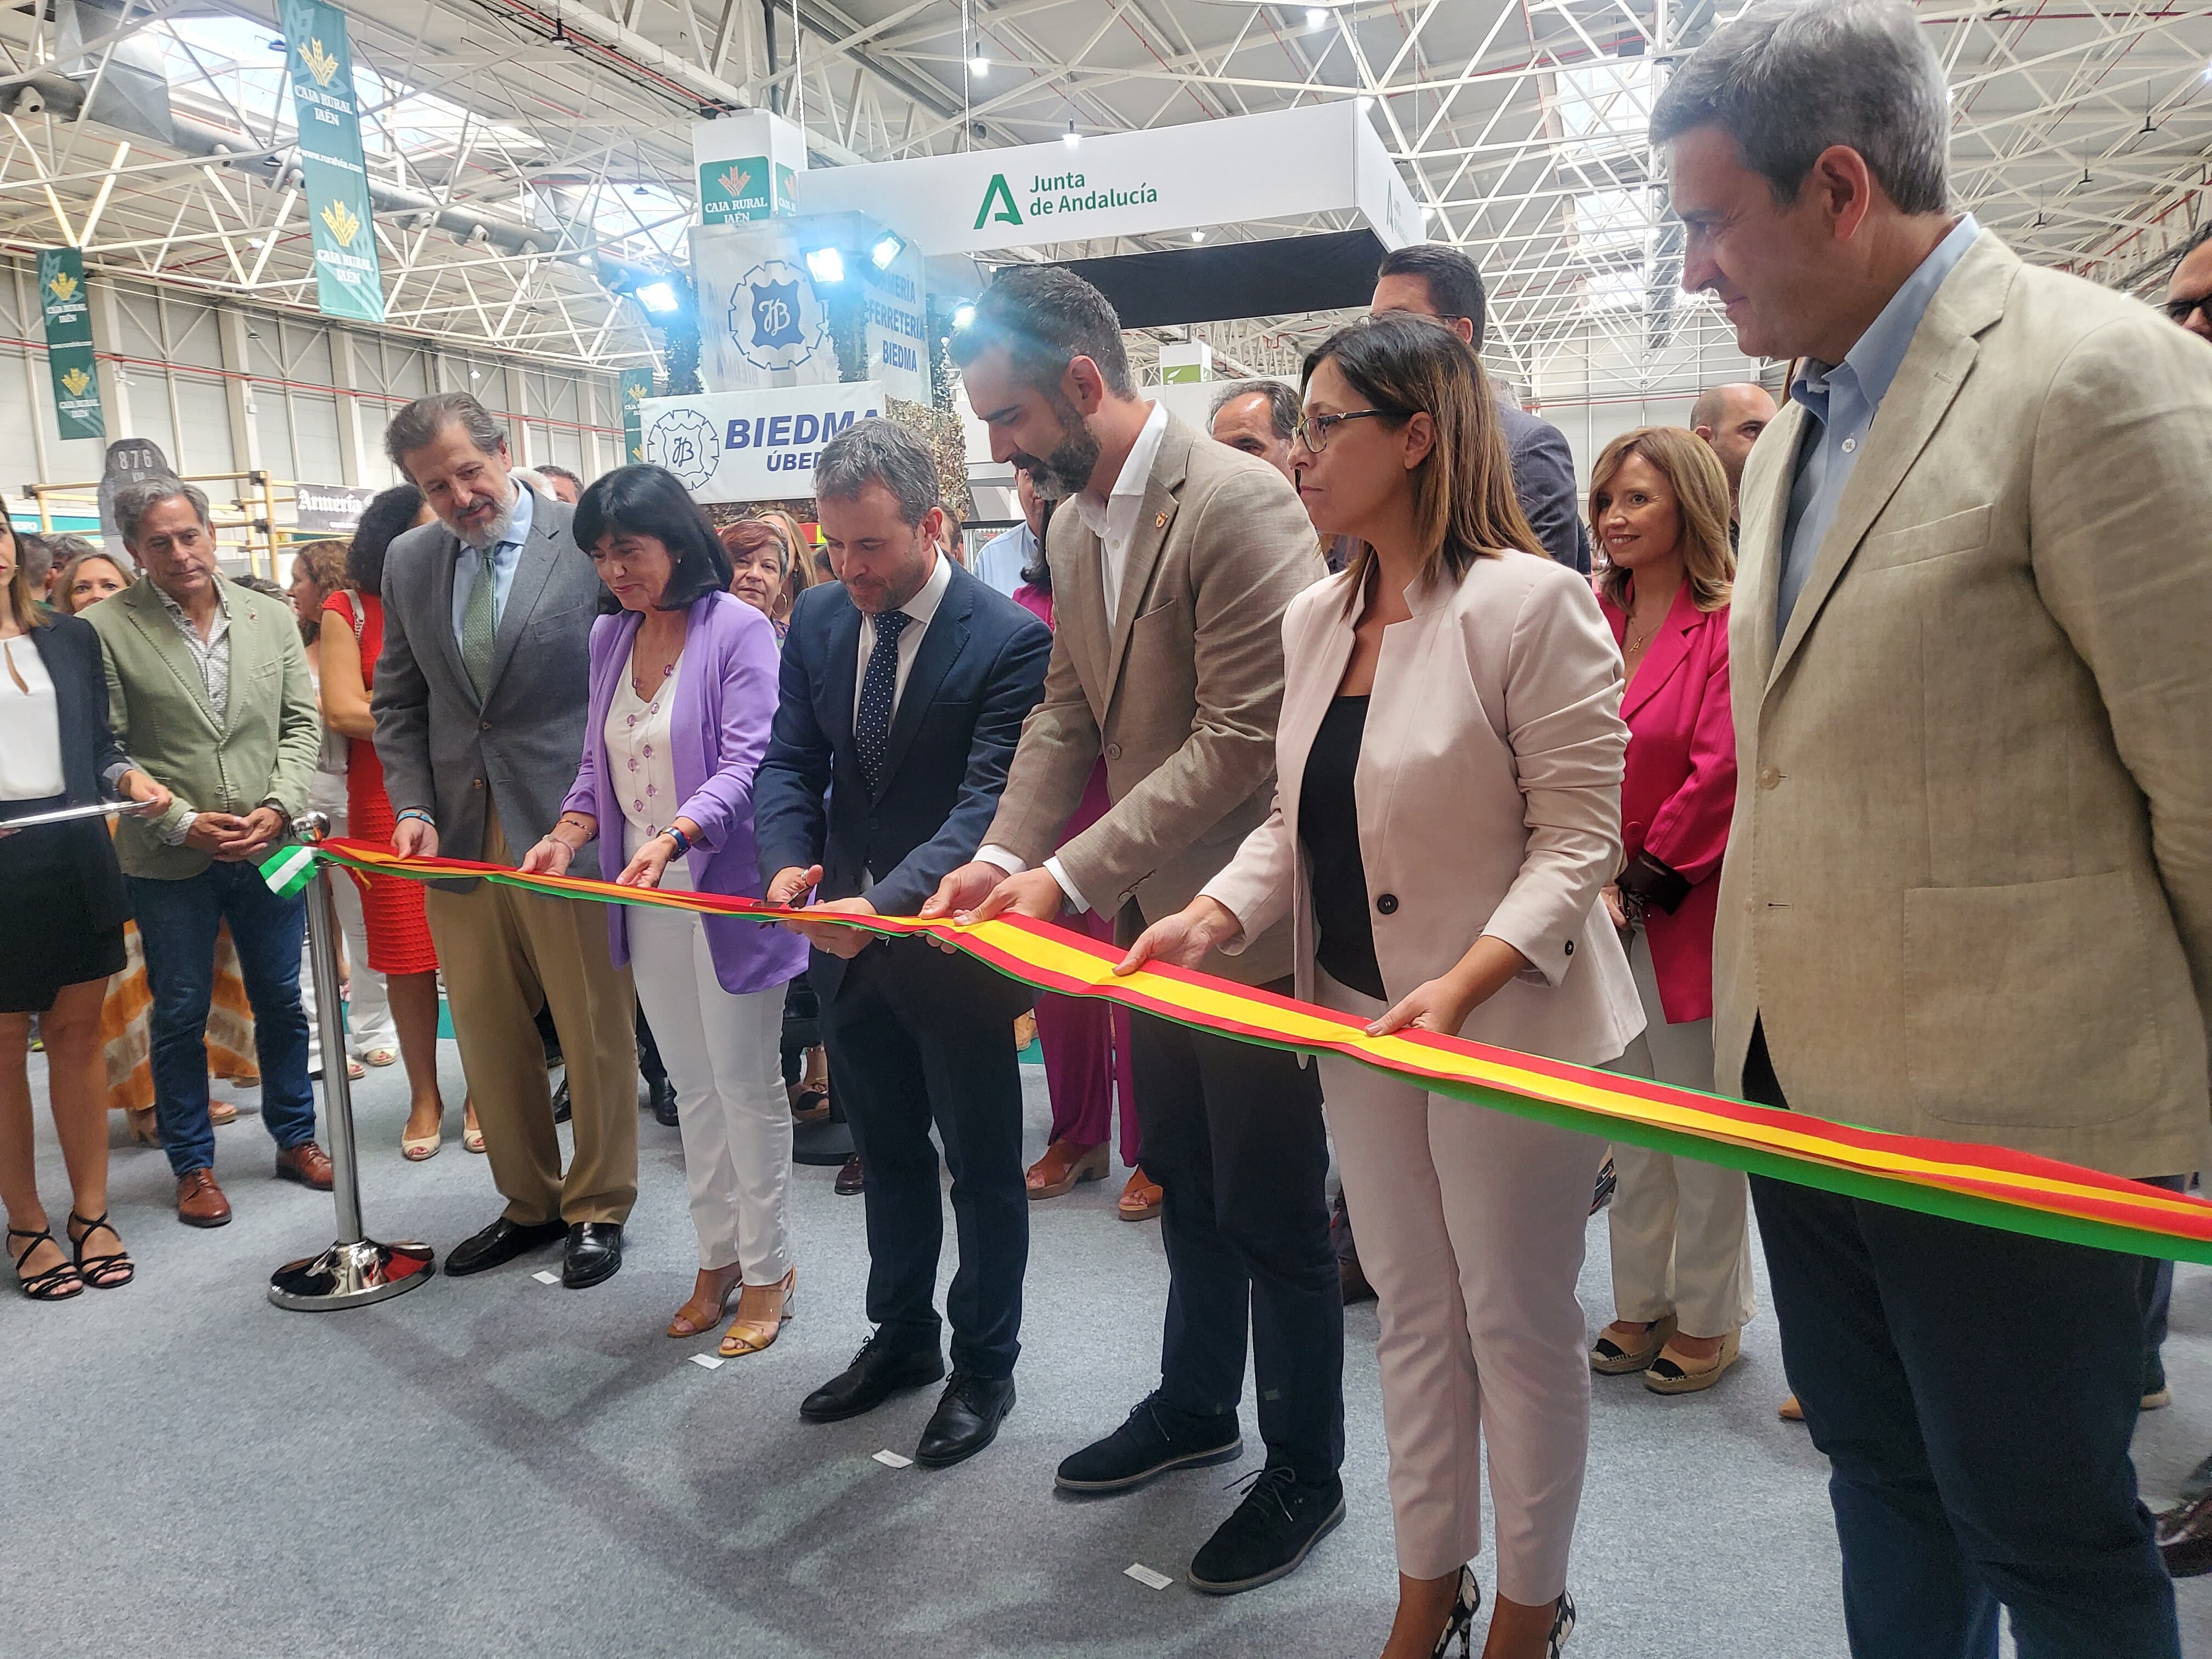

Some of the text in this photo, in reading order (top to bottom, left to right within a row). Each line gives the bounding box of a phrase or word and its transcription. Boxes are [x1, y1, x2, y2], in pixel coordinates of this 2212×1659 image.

[320, 93, 354, 115] RURAL
[301, 149, 363, 174] www.ruralvia.com
[1029, 172, 1085, 193] Junta
[705, 197, 768, 213] CAJA RURAL
[1030, 182, 1158, 216] de Andalucía
[341, 254, 375, 272] RURAL
[868, 298, 926, 342] FERRETERIA
[882, 340, 918, 373] BIEDMA
[298, 489, 365, 514] Armería
